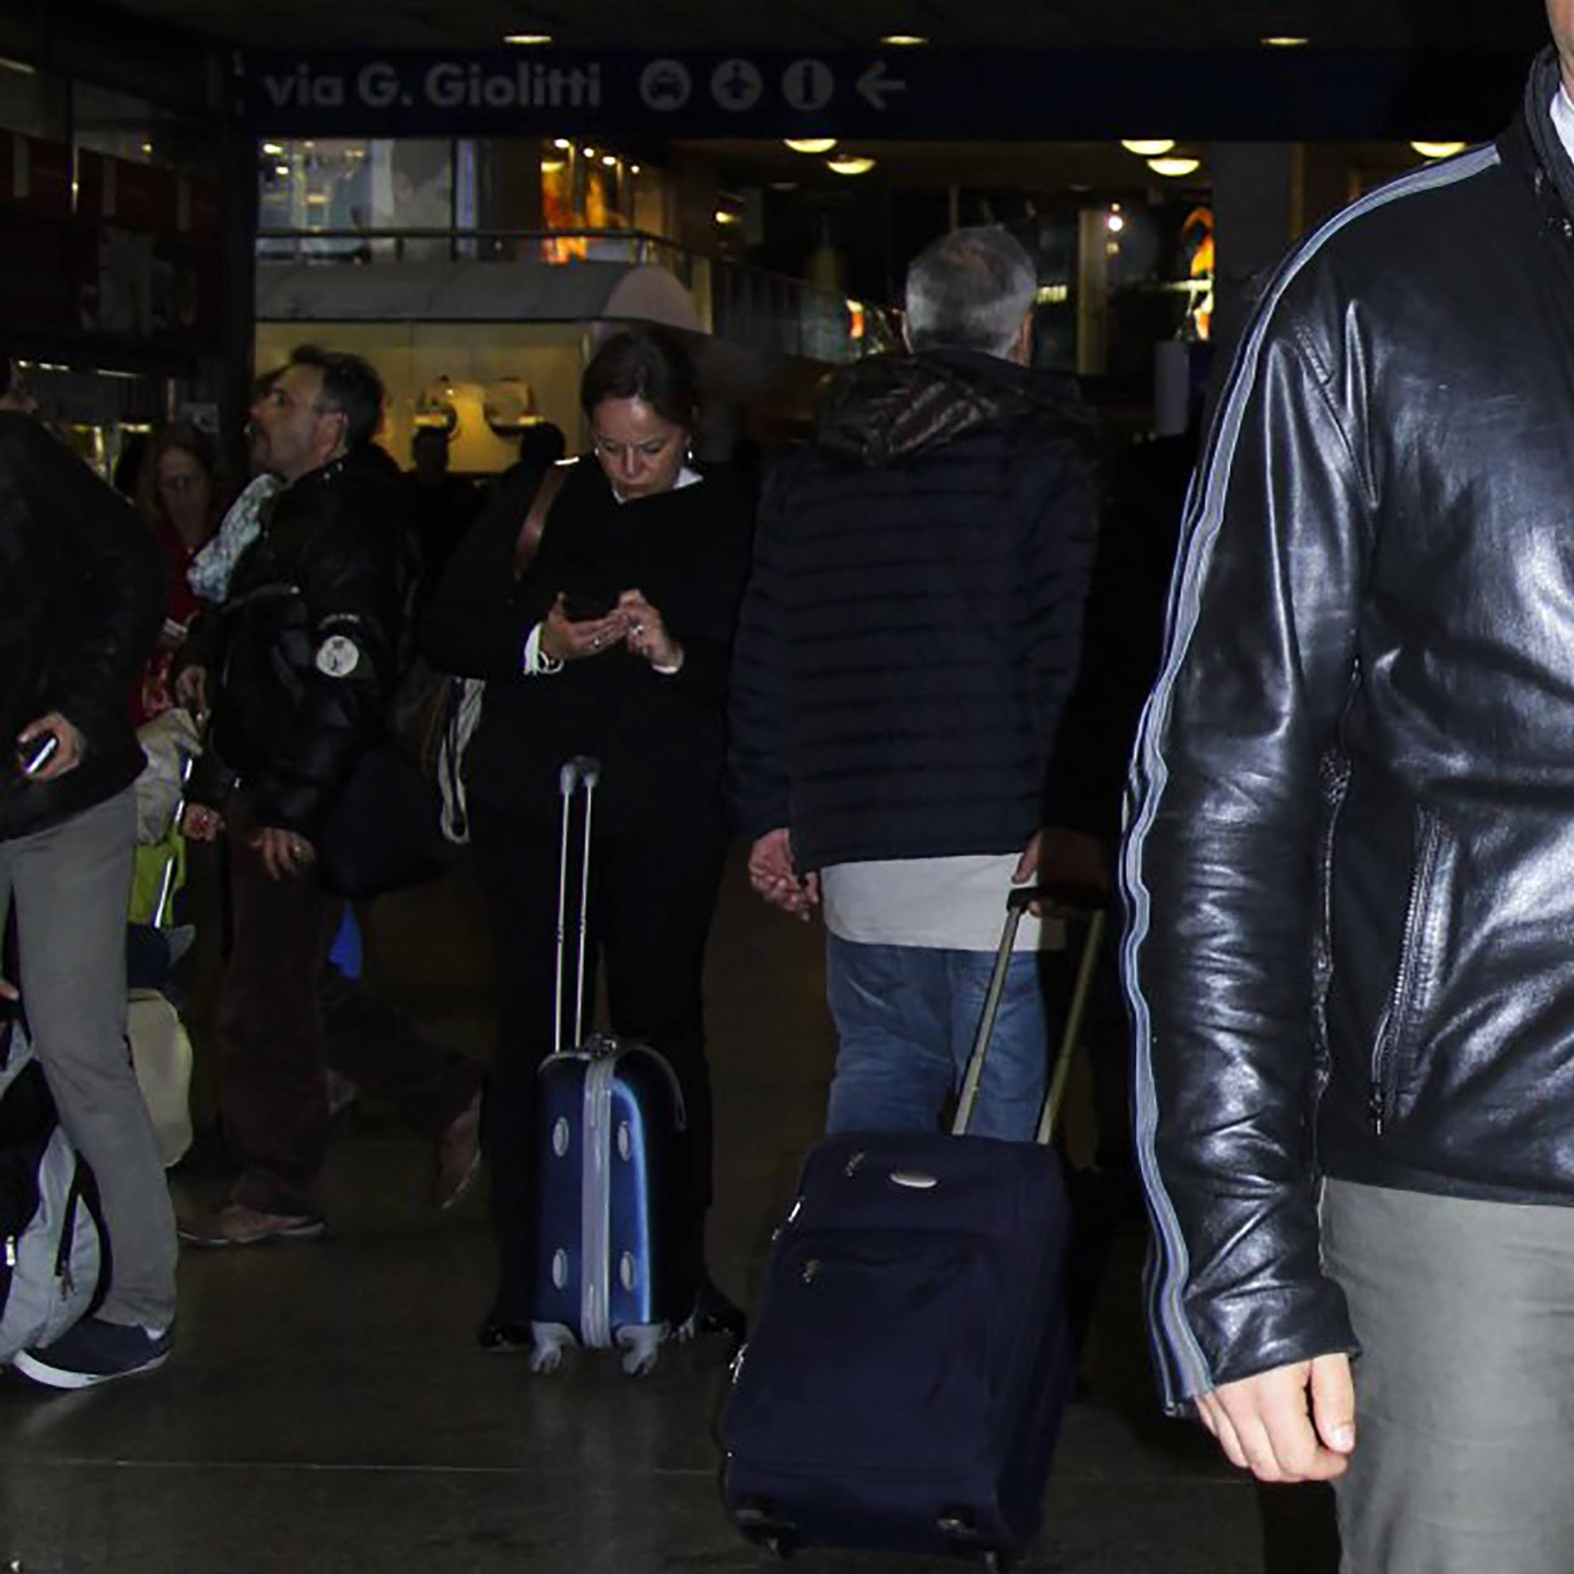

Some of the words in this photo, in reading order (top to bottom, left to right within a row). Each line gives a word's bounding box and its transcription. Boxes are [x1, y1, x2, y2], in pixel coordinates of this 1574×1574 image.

[263, 63, 343, 107] via
[357, 61, 414, 108] G.
[423, 60, 601, 108] Giolitti
